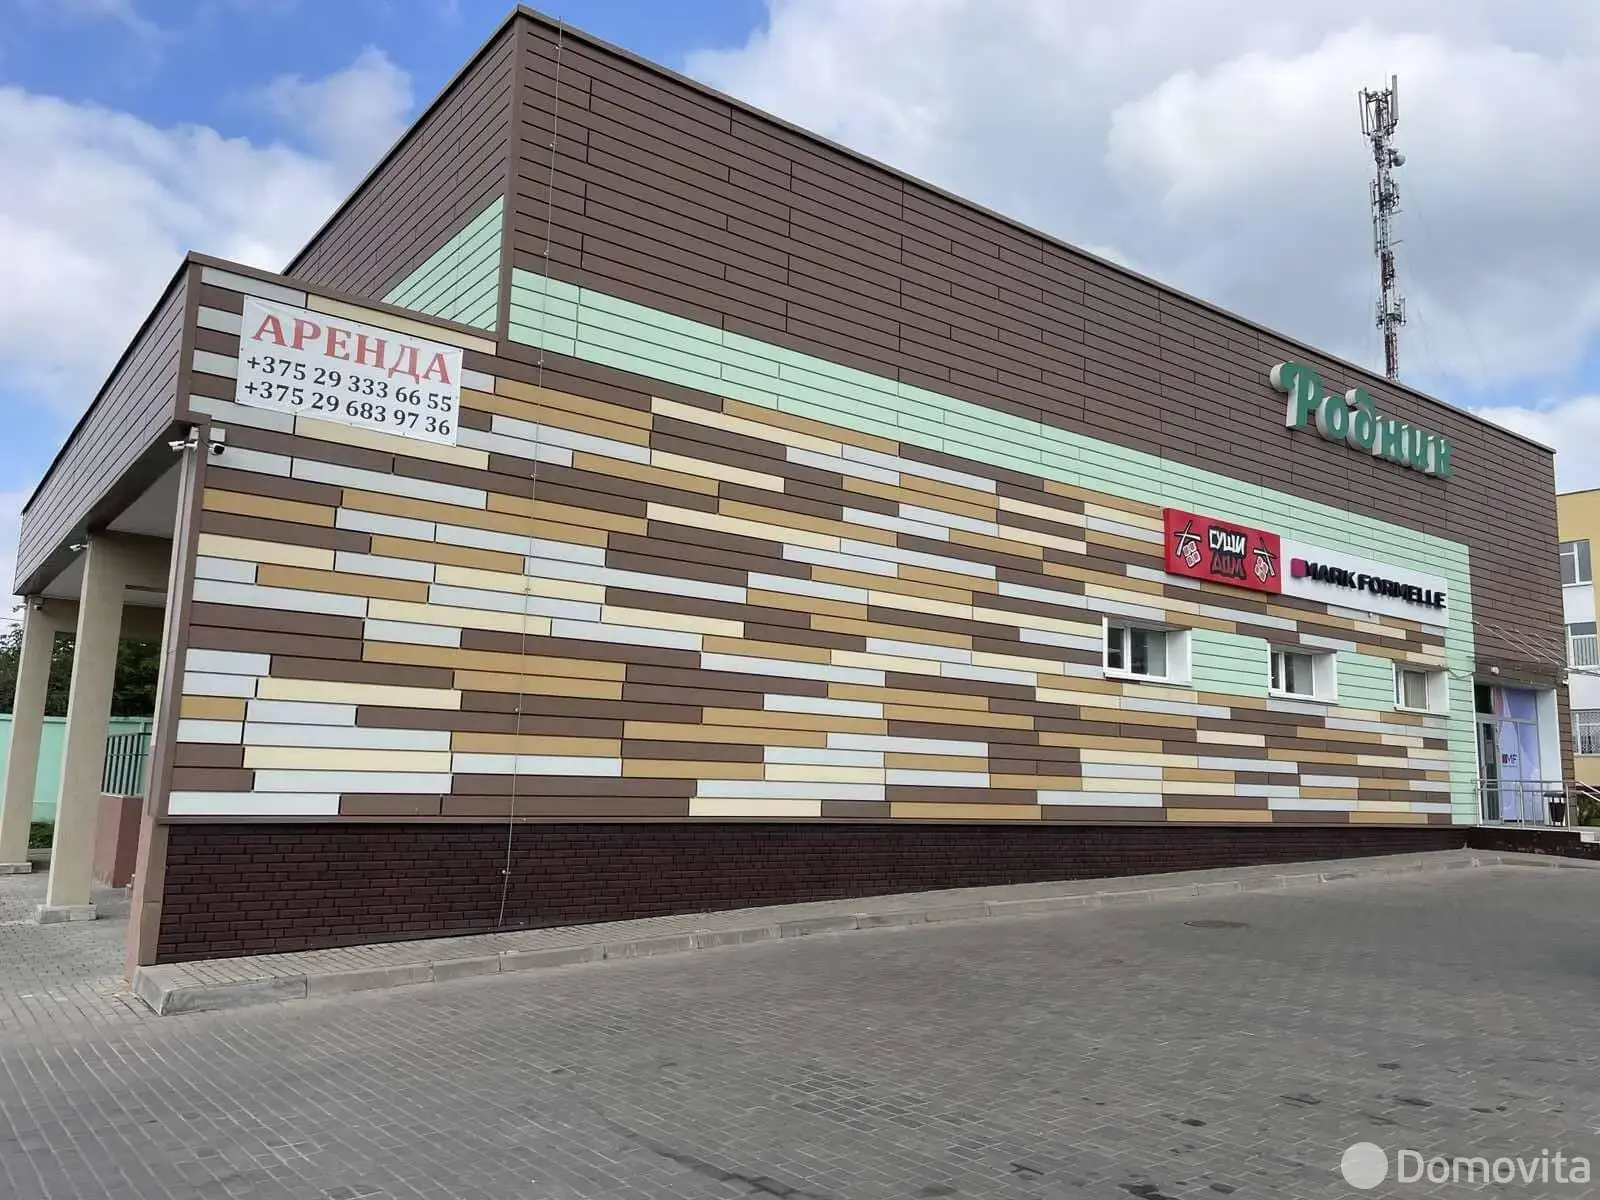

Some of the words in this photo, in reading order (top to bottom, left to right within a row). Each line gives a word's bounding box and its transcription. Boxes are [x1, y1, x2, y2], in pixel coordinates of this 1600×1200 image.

[251, 314, 452, 385] АРЕНДА
[244, 381, 304, 406] +375
[311, 392, 339, 412] 29
[346, 401, 387, 422] 683
[394, 410, 419, 429] 97
[425, 417, 450, 436] 36
[246, 355, 306, 381] +375
[313, 367, 341, 388] 29
[348, 375, 388, 398] 333
[395, 387, 421, 405] 66
[427, 393, 452, 412] 55
[1270, 360, 1455, 479] Родник
[1209, 528, 1246, 556] СУШИ
[1304, 560, 1357, 589] MARK
[1357, 573, 1447, 609] FORMELLE
